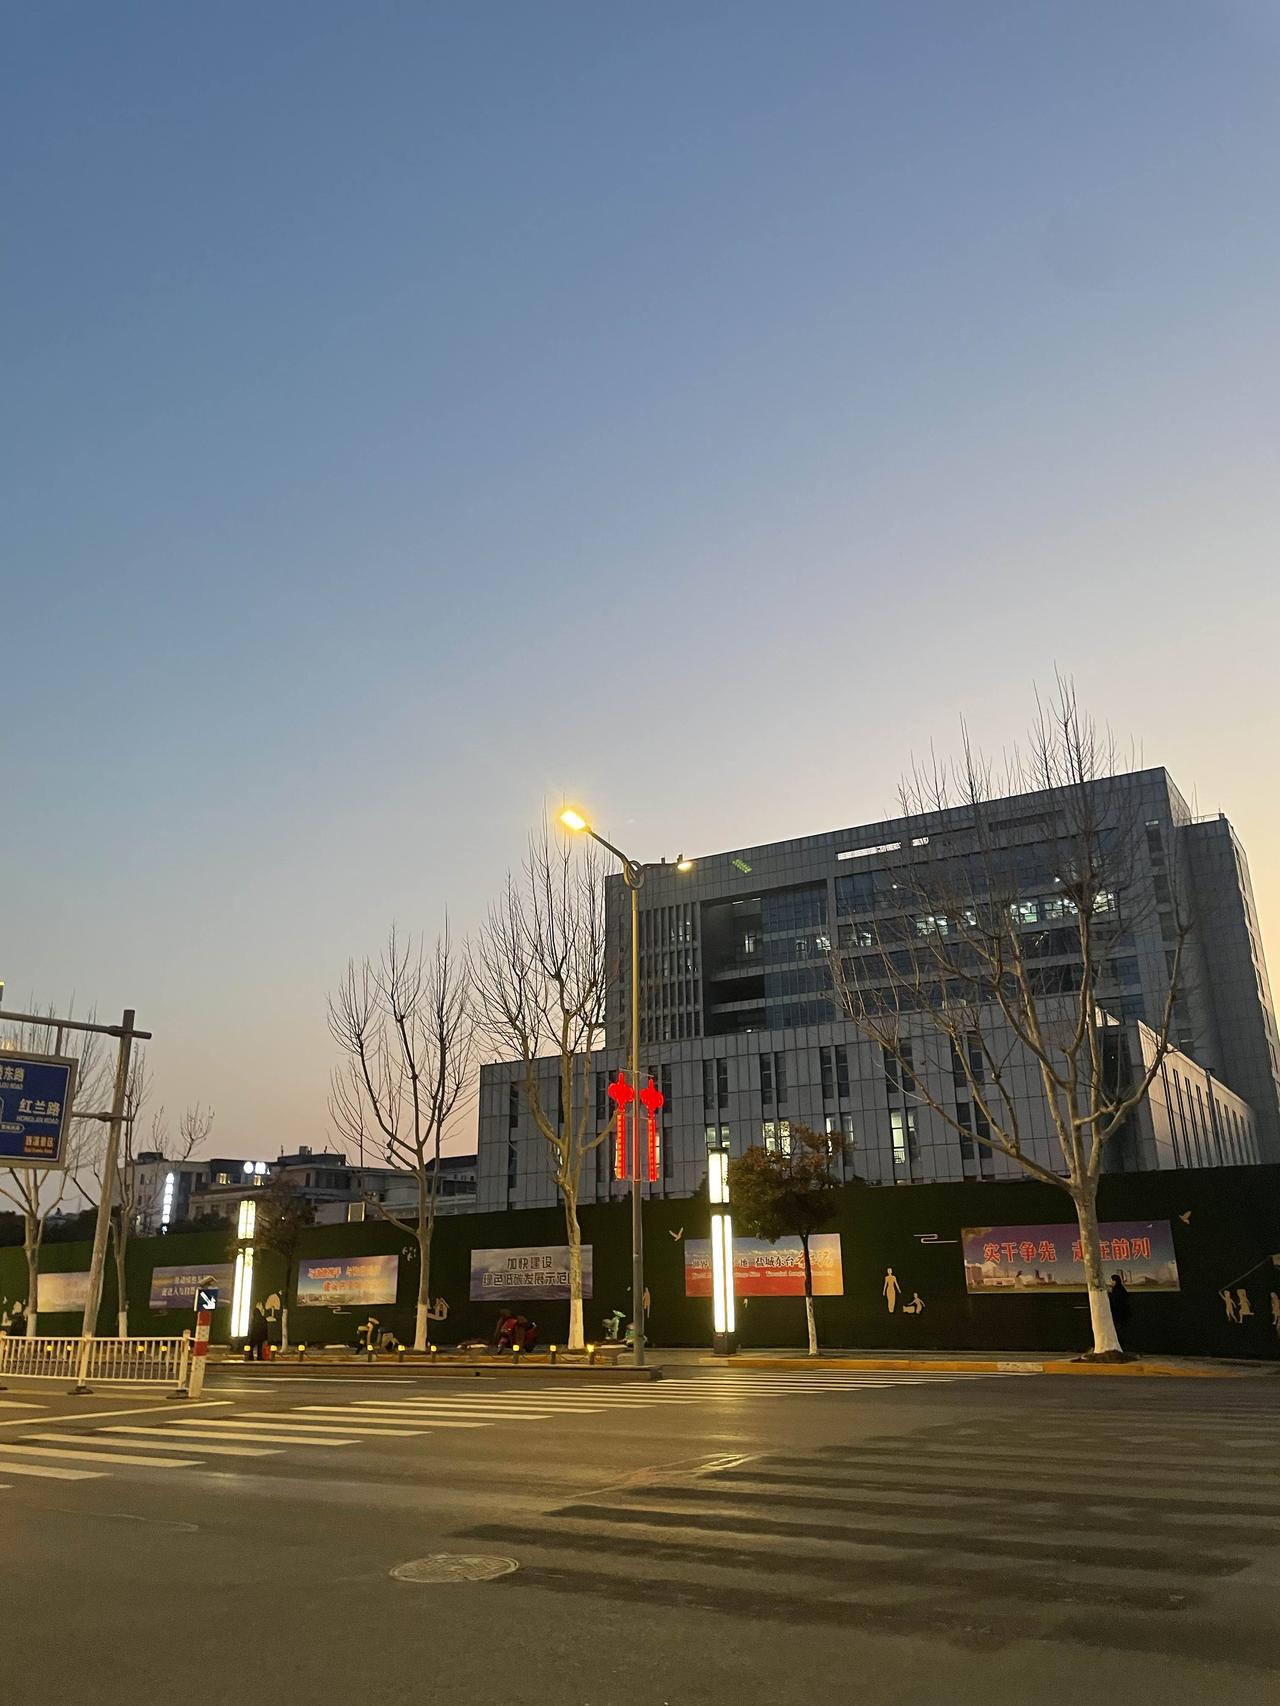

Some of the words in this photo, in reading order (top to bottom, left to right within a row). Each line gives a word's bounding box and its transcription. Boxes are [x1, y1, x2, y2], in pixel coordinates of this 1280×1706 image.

[18, 1099, 60, 1116] 红兰路
[983, 1241, 1057, 1264] 实干争先
[507, 1256, 552, 1270] 加快建设
[483, 1271, 571, 1287] 绿色低碳发展示范
